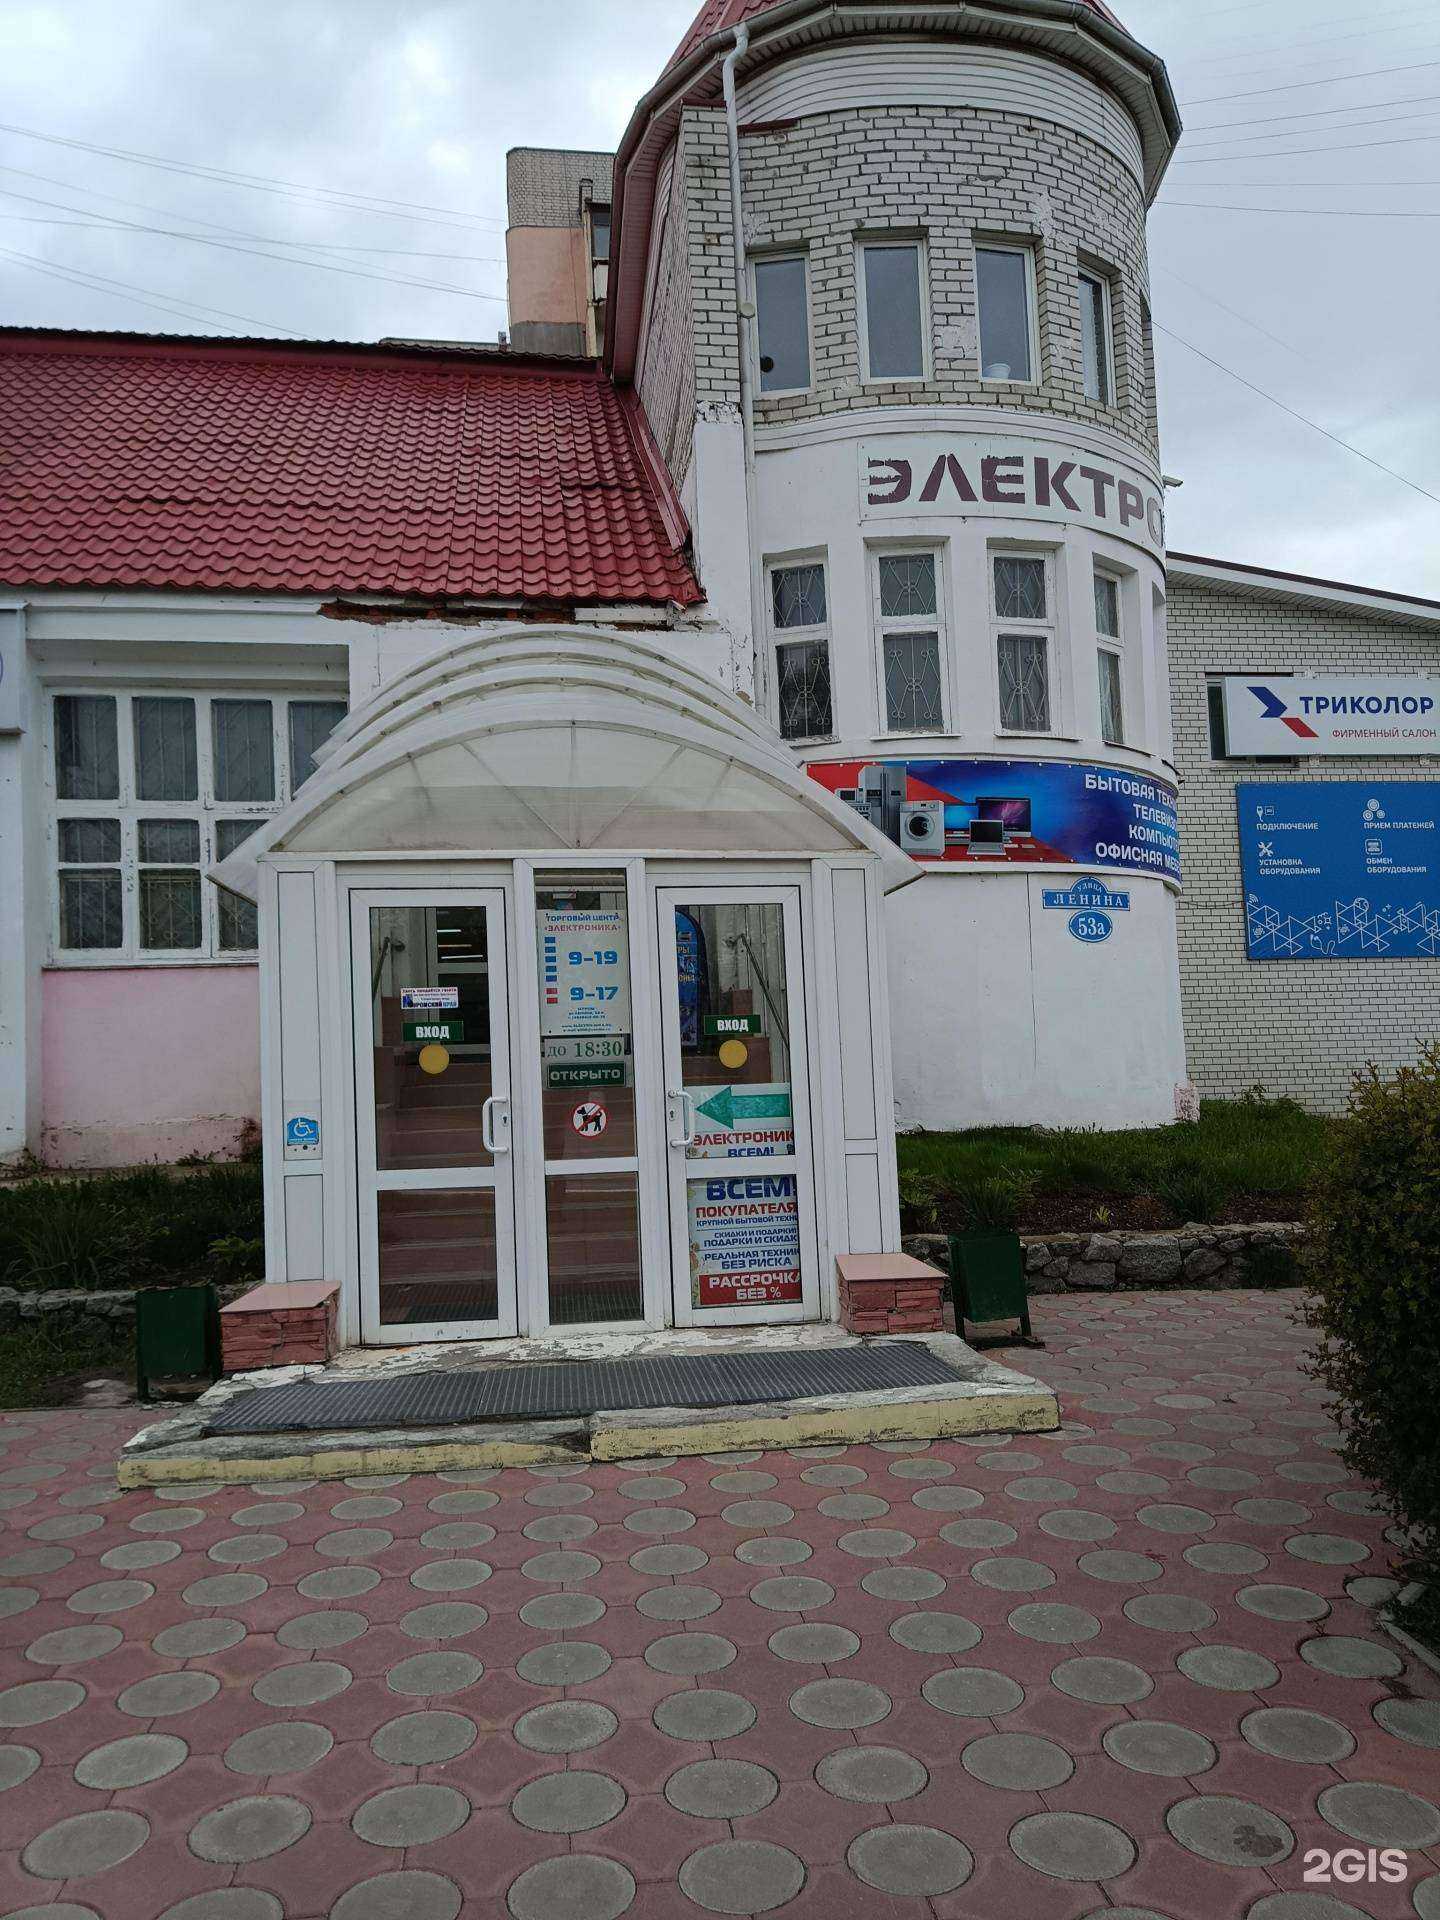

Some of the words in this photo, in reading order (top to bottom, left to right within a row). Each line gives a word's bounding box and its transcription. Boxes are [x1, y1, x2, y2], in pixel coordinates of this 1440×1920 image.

[1299, 696, 1434, 714] ТРИКОЛОР
[1332, 726, 1400, 738] ФИРМЕННЫЙ
[1401, 728, 1437, 738] САЛОН
[1085, 774, 1155, 800] БЫТОВАЯ
[1256, 822, 1319, 831] ПОДКЛЮЧЕНИЕ
[1392, 820, 1435, 829] ПЛАТЕЖЕЙ
[1096, 842, 1163, 866] ОФИСНАЯ
[1259, 858, 1303, 866] УСТАНОВКА
[1366, 857, 1393, 865] ОБМЕН
[1259, 867, 1321, 875] ОБОРУДОВАНИЯ
[1366, 866, 1427, 874] ОБОРУДОВАНИЯ
[1053, 894, 1123, 906] ЛЕНИНА
[546, 914, 591, 922] ТОРГОВЫЙ
[592, 913, 620, 921] ЦЕНТР
[717, 1019, 749, 1032] ВХОД
[415, 1025, 449, 1039] ВХОД
[574, 1041, 622, 1057] 18:30
[550, 1069, 621, 1080] ОТКРЫТО
[696, 1217, 734, 1227] КРУПНОЙ
[735, 1214, 774, 1225] БЫТОВОЙ
[714, 1230, 747, 1238] СКИДКИ
[704, 1237, 753, 1247] ПОДАРКИ
[755, 1236, 762, 1244] И
[704, 1250, 759, 1261] РЕАЛЬНАЯ
[721, 1260, 746, 1270] БЕЗ
[748, 1257, 792, 1268] РИСКА
[736, 1288, 767, 1300] БЕЗ
[770, 1286, 781, 1298] %
